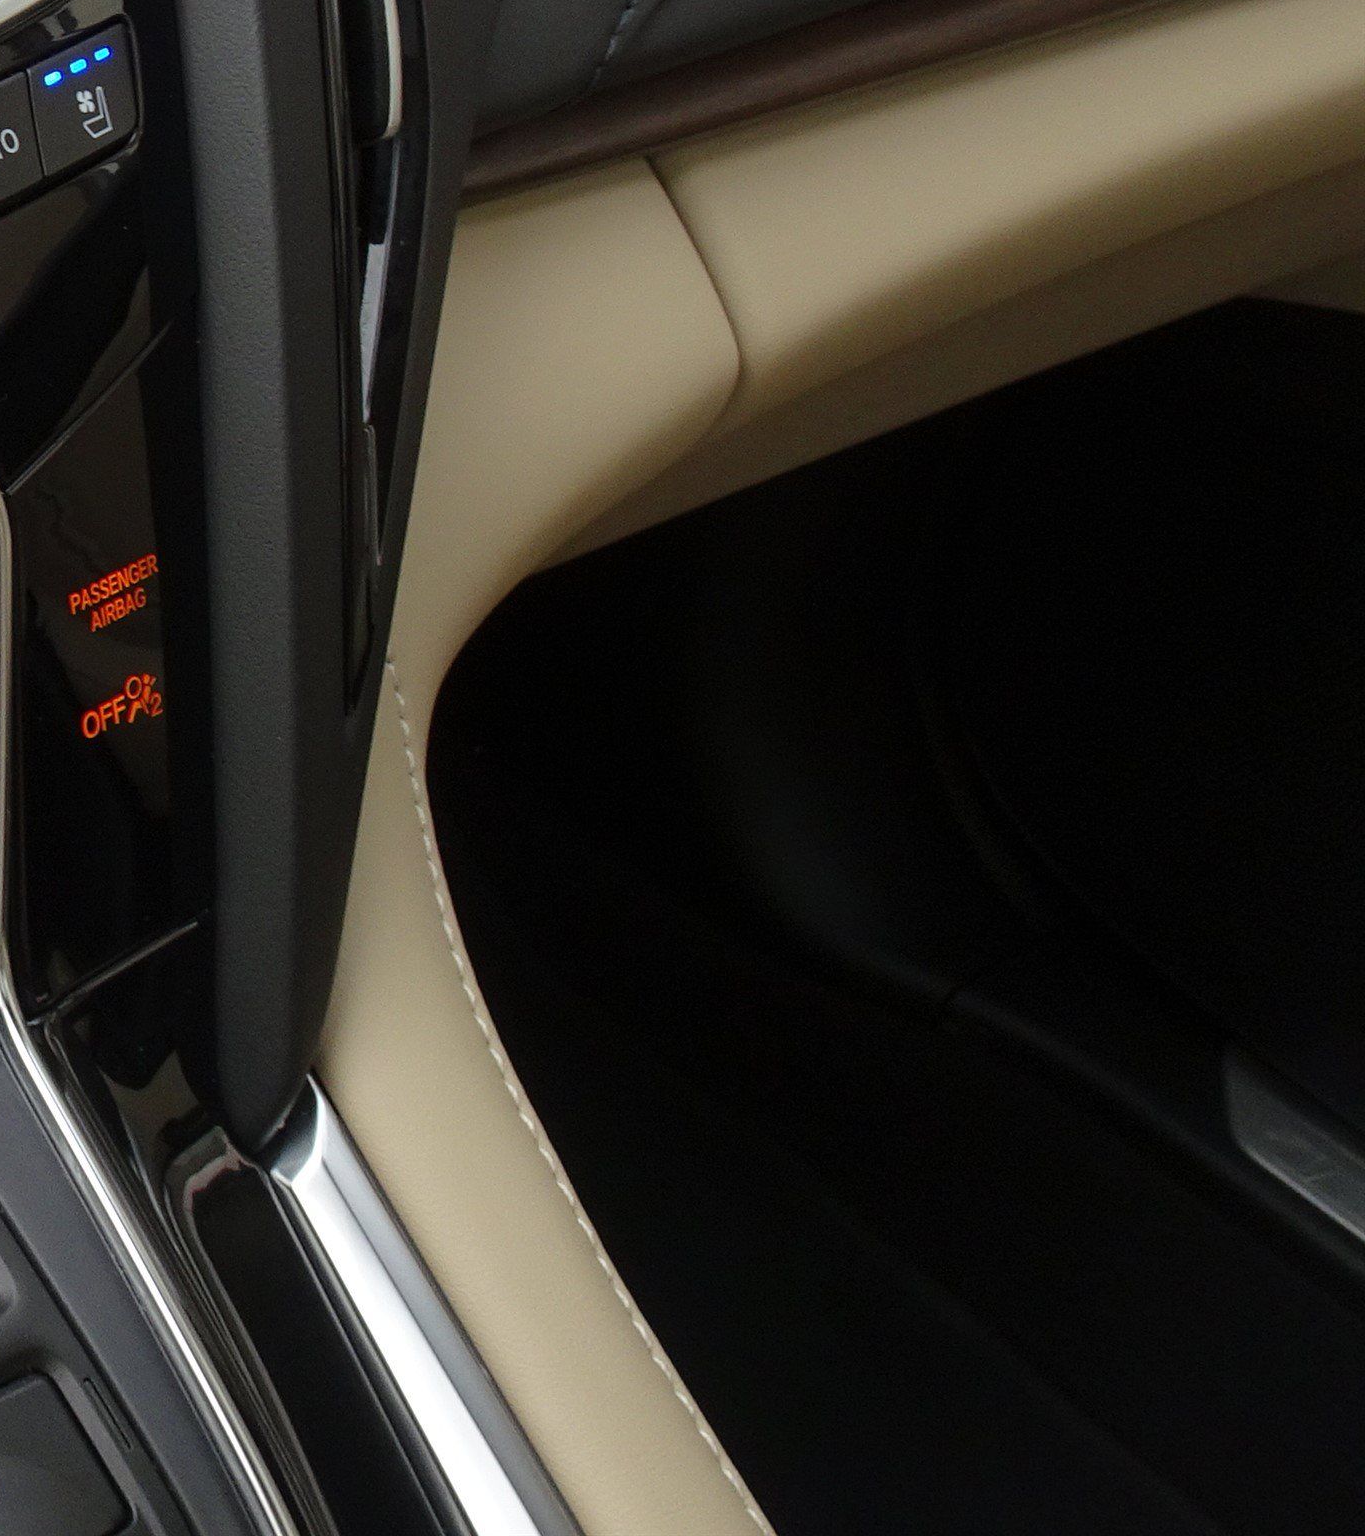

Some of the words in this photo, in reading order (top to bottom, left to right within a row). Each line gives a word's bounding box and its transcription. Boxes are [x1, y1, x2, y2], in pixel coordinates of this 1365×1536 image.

[69, 553, 159, 616] PASSENGER
[89, 586, 148, 633] AIRBAG
[81, 694, 127, 739] OFF
